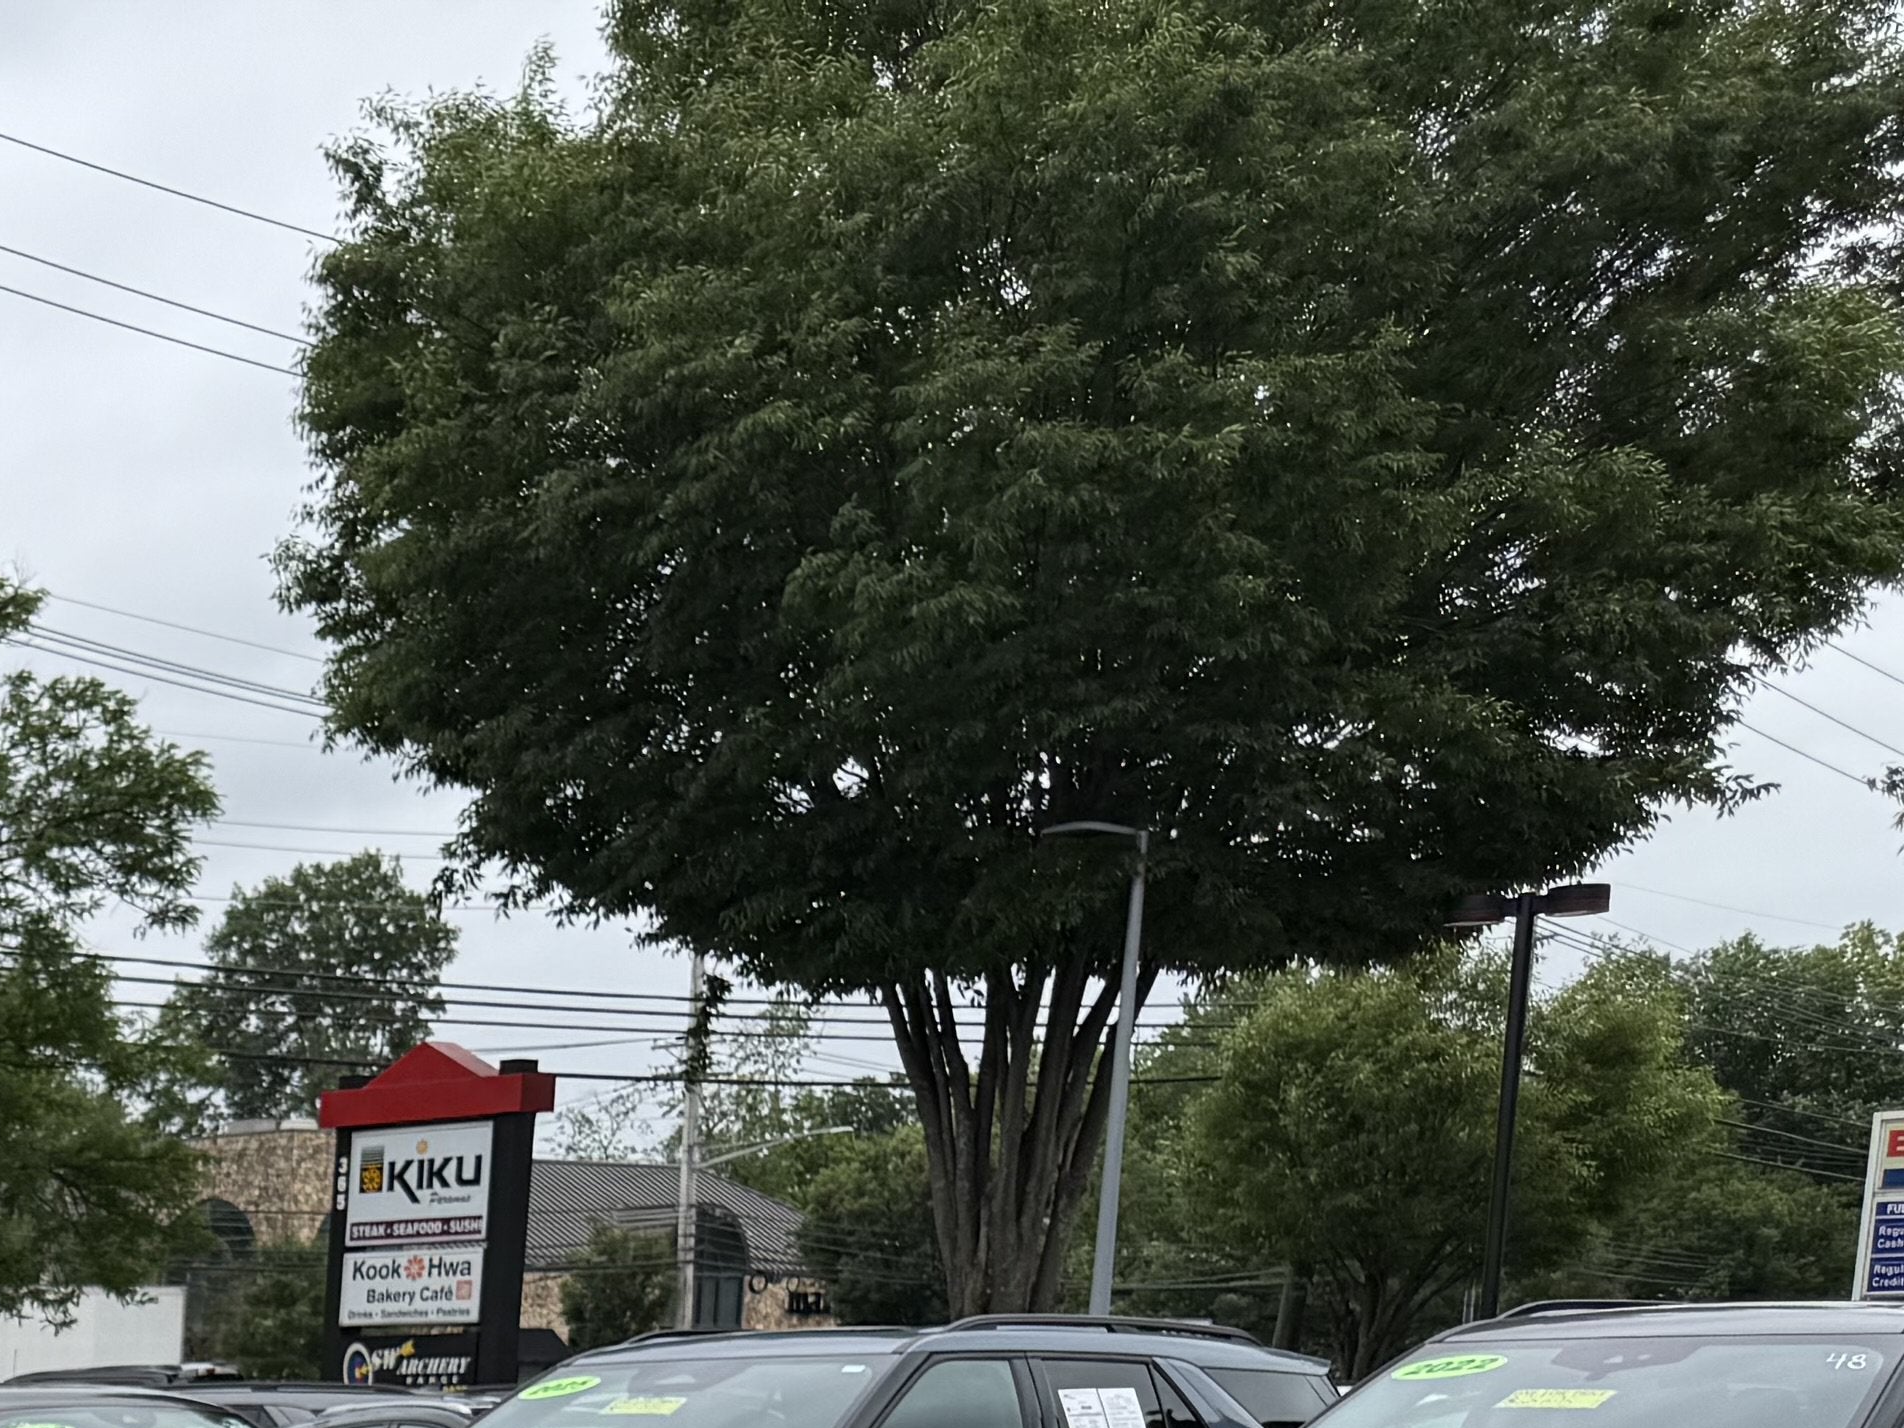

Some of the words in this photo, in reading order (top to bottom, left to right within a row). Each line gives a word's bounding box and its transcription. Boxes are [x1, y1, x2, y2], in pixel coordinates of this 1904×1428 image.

[1887, 1203, 1904, 1214] FU
[352, 1224, 386, 1238] STEAK
[392, 1221, 442, 1236] SEAFOOD
[449, 1218, 483, 1233] SUSHI
[352, 1259, 402, 1281] Kook
[427, 1256, 472, 1278] Hwa
[366, 1288, 416, 1306] Bakery
[419, 1285, 454, 1303] Café
[396, 1356, 471, 1375] ARCHERY
[1825, 1353, 1867, 1370] 48
